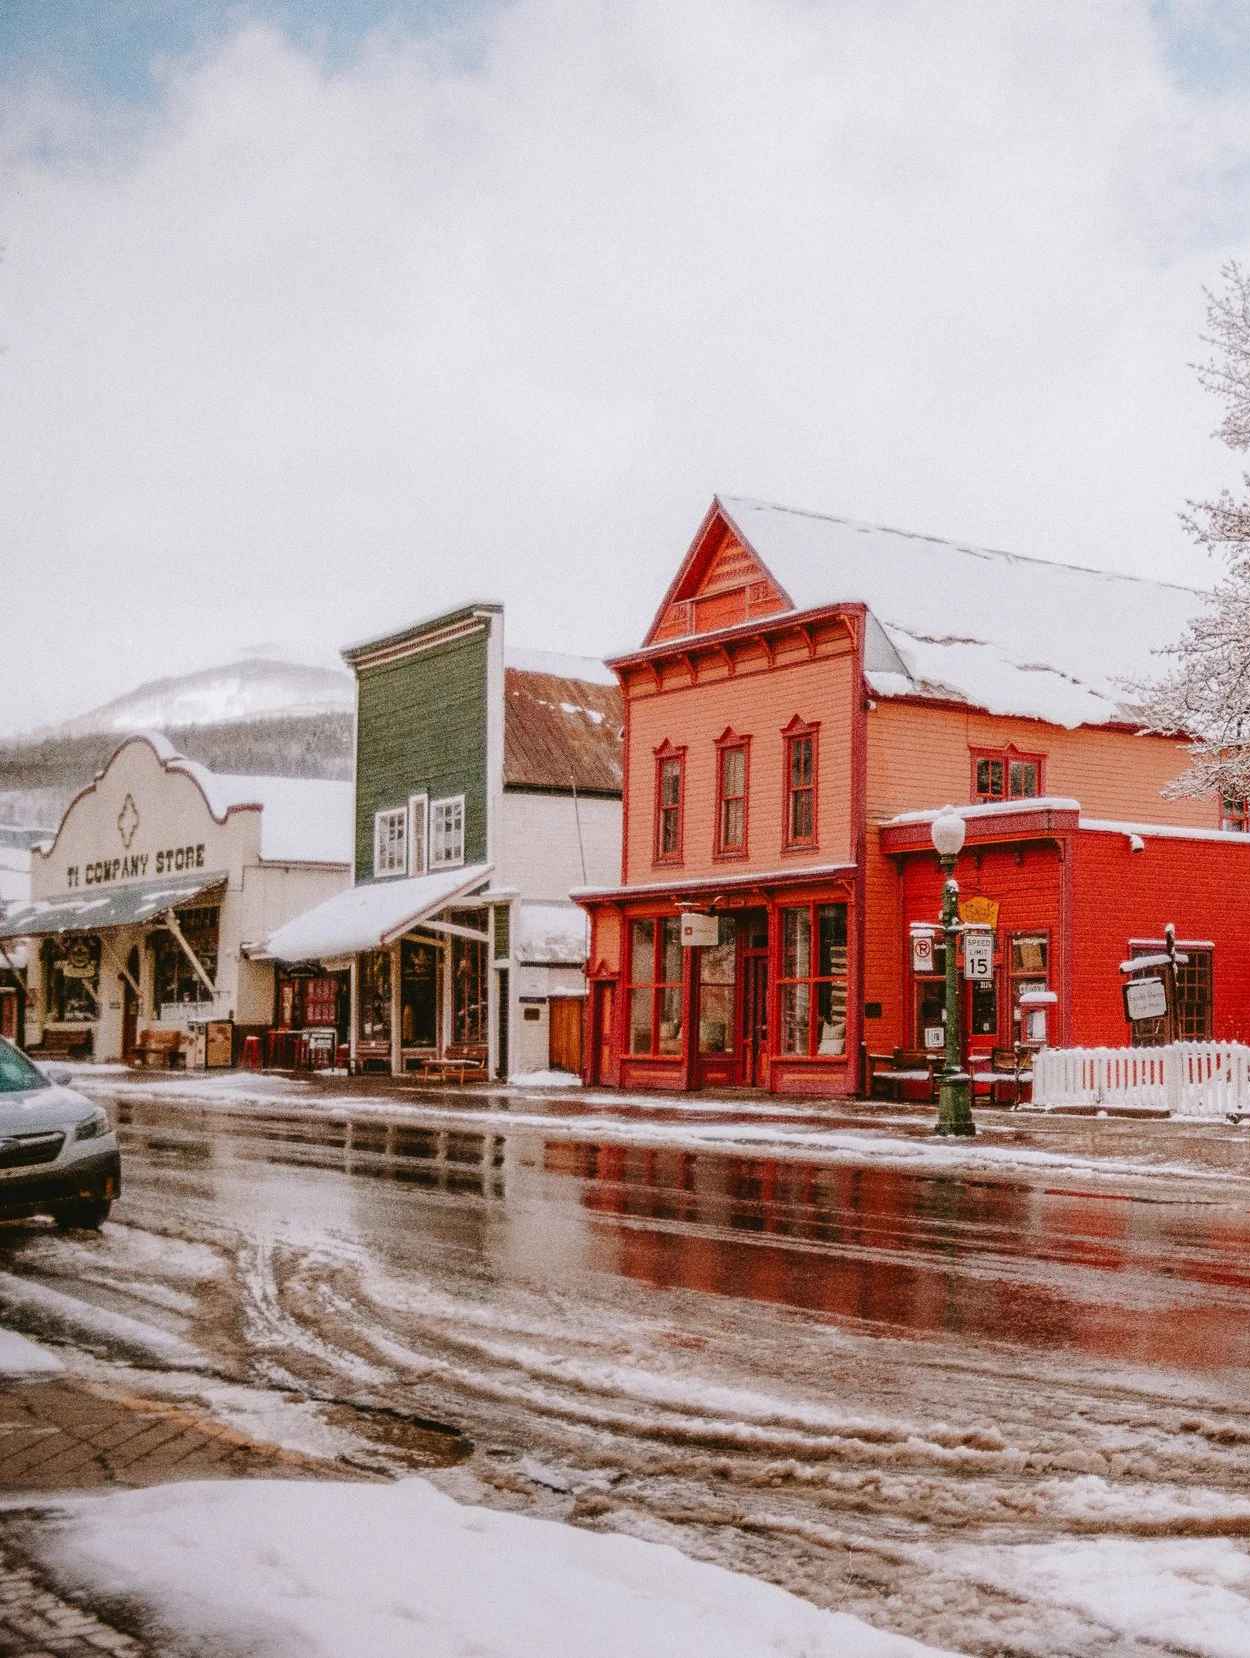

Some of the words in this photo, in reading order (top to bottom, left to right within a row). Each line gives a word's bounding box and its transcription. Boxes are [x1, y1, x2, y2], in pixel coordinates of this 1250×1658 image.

[85, 853, 149, 885] COMPANY
[156, 844, 205, 873] STORE
[967, 939, 991, 947] SPEED
[969, 958, 988, 974] 15
